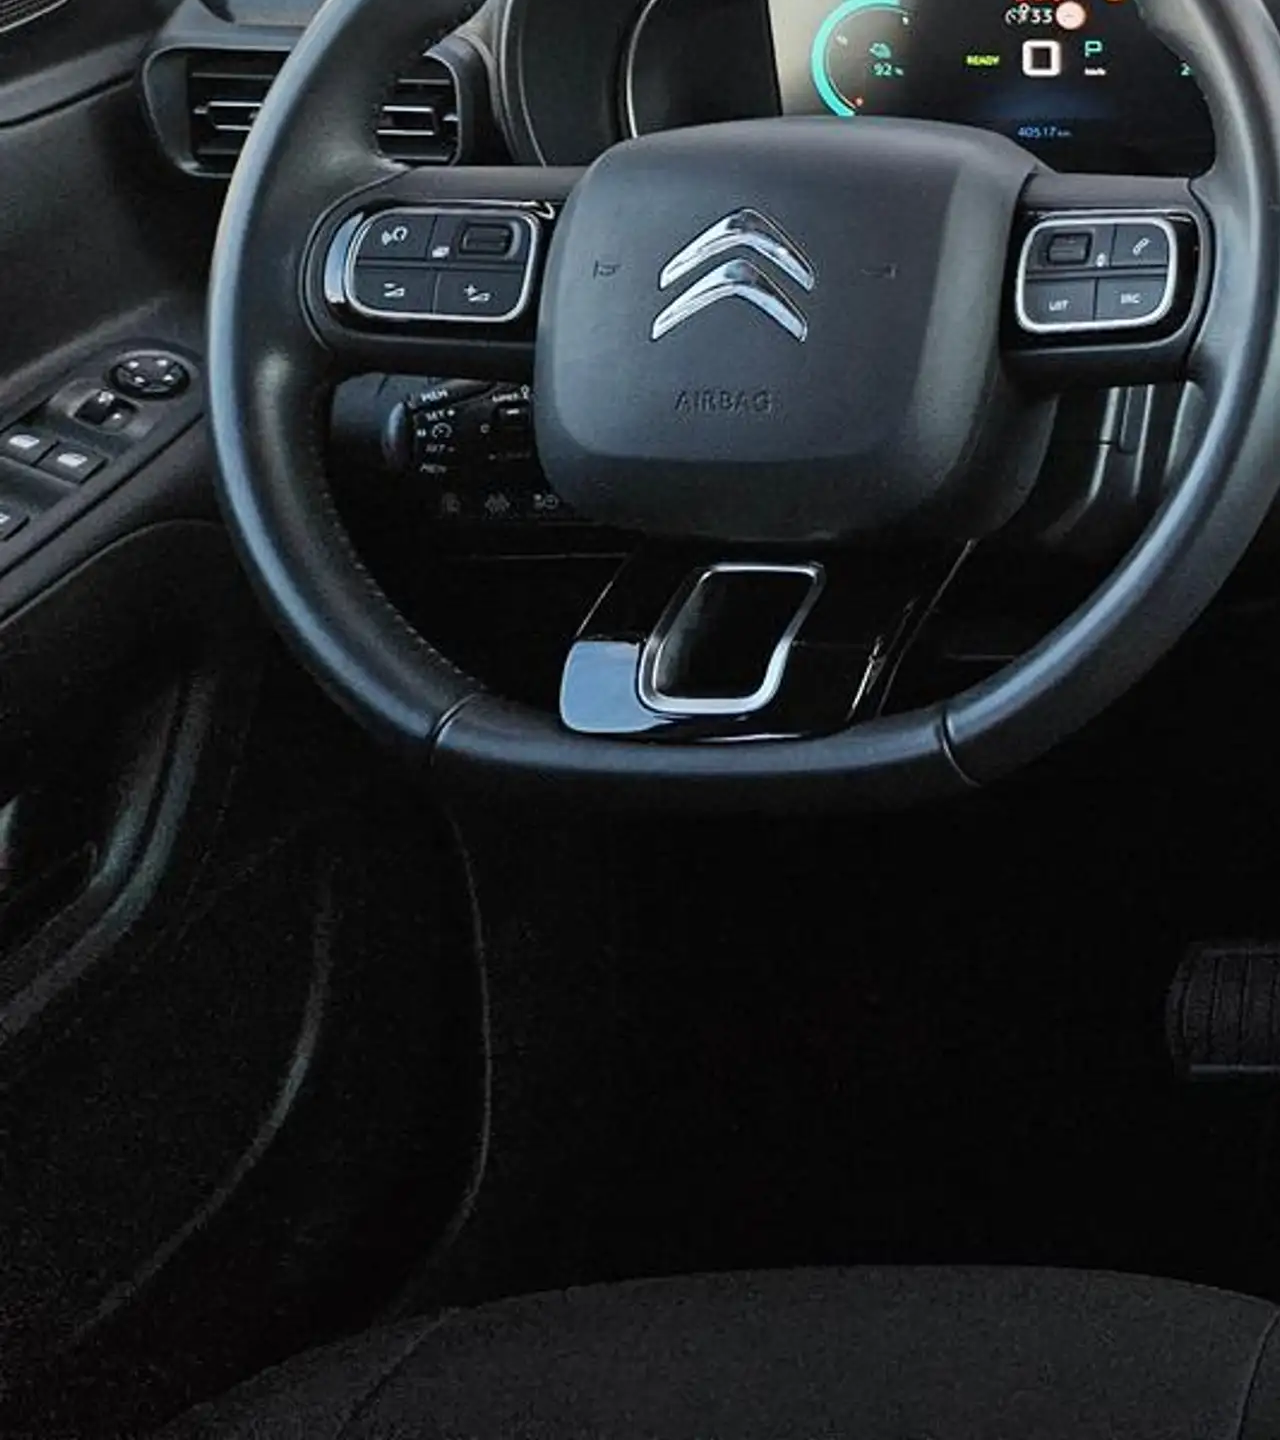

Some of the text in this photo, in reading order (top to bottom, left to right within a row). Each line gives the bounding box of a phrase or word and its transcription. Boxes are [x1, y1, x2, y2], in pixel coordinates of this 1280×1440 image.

[1084, 40, 1103, 58] P
[966, 55, 1000, 66] READY
[873, 63, 892, 76] 92
[674, 389, 771, 412] AIRBAG
